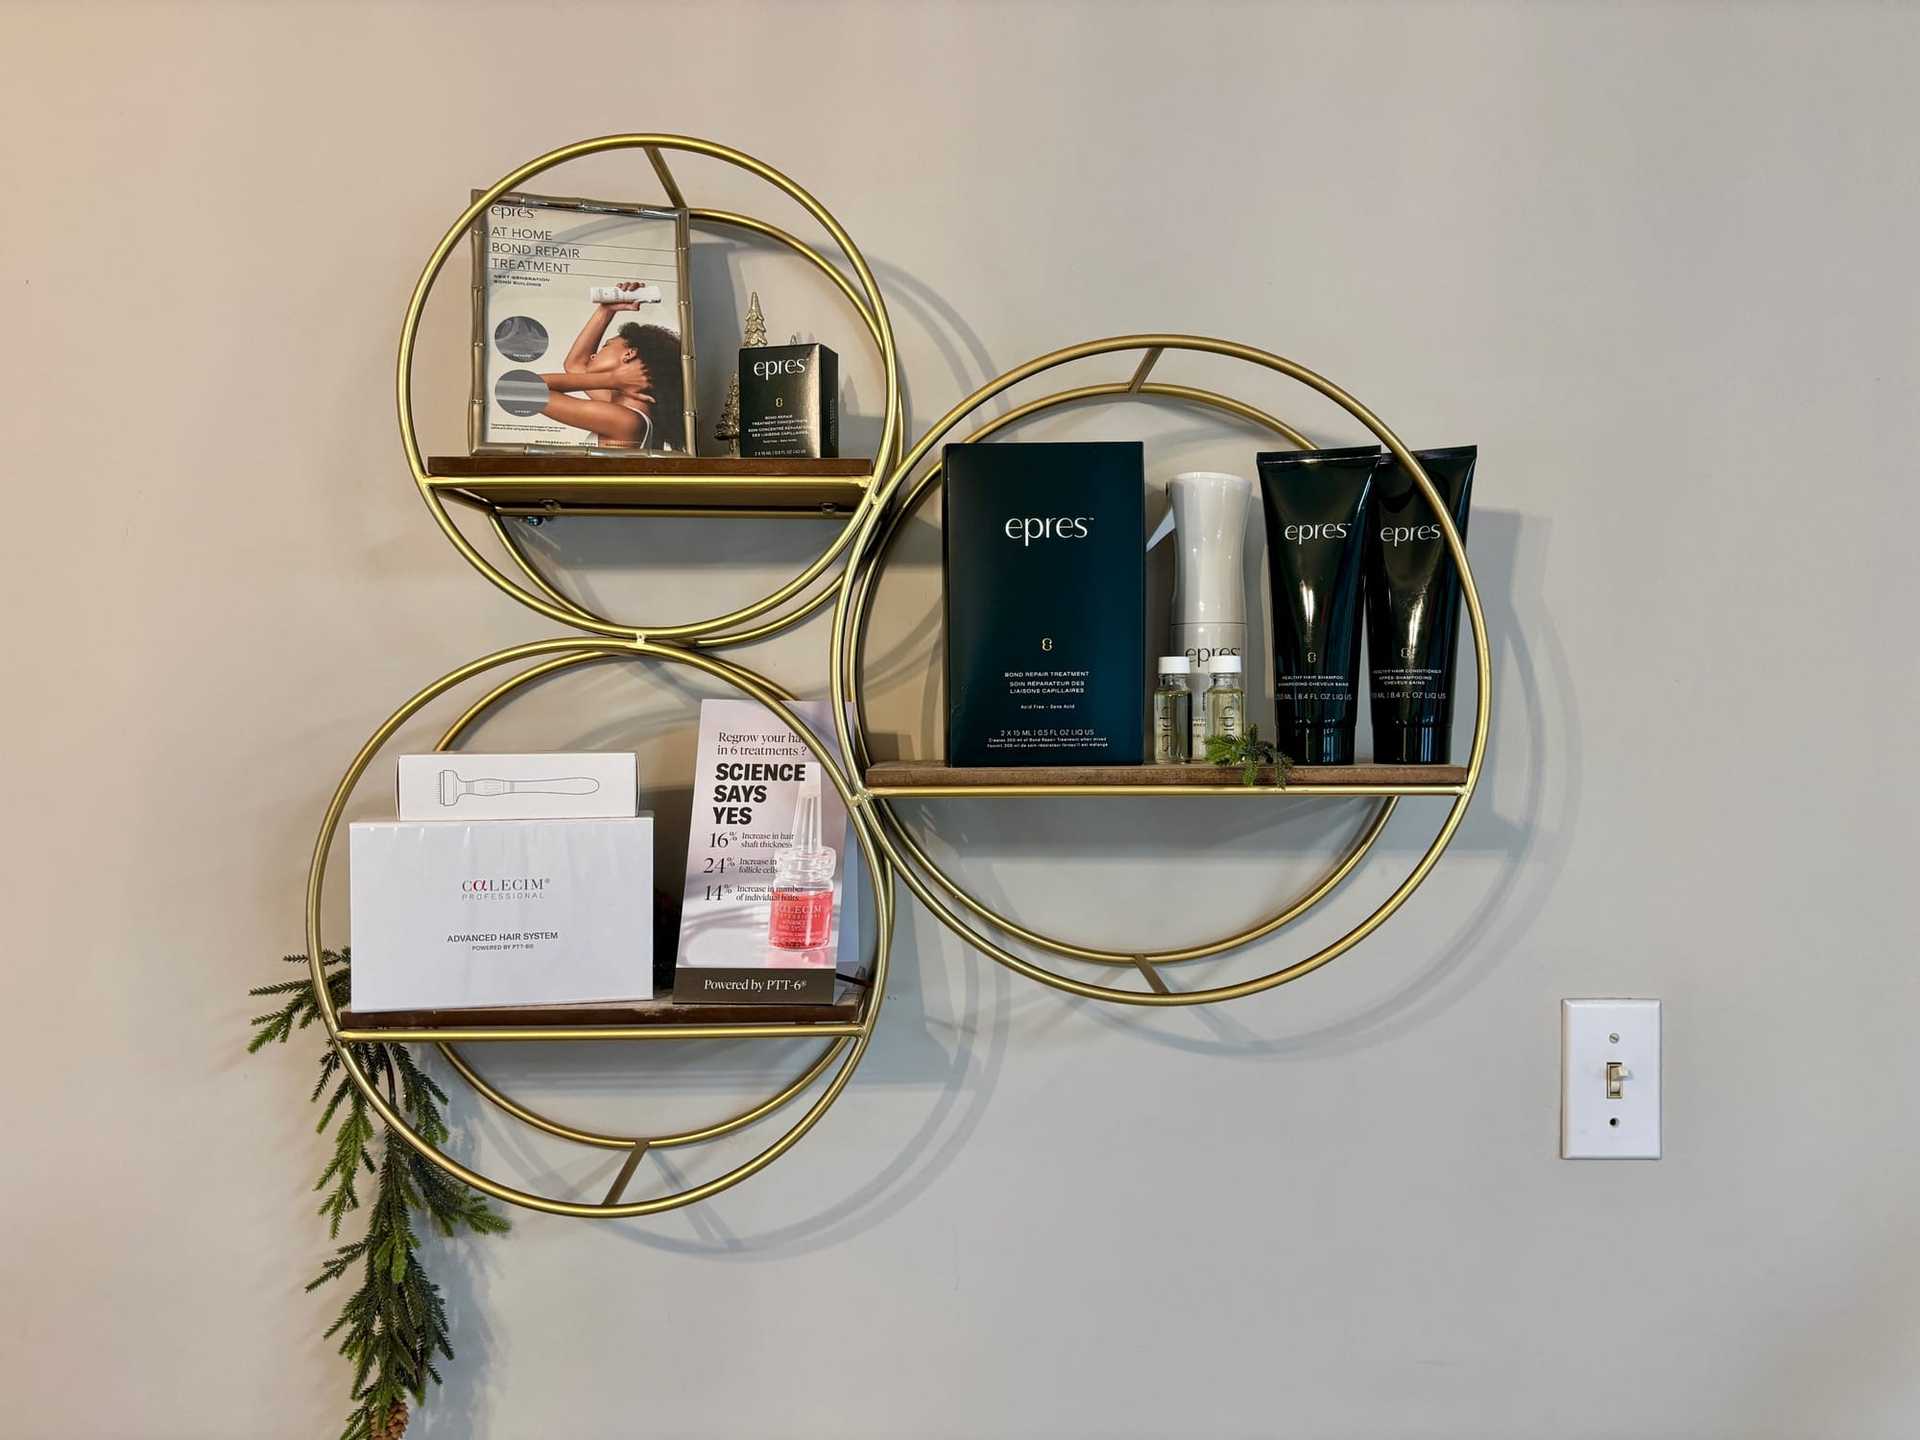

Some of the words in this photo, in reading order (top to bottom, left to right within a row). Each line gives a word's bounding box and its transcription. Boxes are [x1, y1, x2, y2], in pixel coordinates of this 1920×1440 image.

[491, 205, 536, 219] epres
[491, 226, 507, 237] AT
[511, 228, 553, 241] HOME
[492, 242, 531, 254] BOND
[535, 246, 580, 258] REPAIR
[491, 258, 571, 273] TREATMENT
[753, 358, 806, 381] epres
[1005, 517, 1089, 547] epres
[1284, 523, 1348, 545] epres
[1379, 523, 1441, 547] epres
[718, 732, 759, 744] Regrow
[761, 733, 785, 745] your
[788, 732, 801, 743] ha
[717, 745, 728, 755] in
[730, 745, 738, 755] 6
[740, 746, 799, 756] treatments
[715, 763, 806, 781] SCIENCE
[713, 784, 767, 803] SAYS
[713, 806, 753, 825] YES
[742, 832, 771, 840] Increase
[772, 832, 779, 840] in
[780, 832, 795, 840] hair
[741, 840, 759, 848] shaft
[759, 840, 793, 848] thickness
[739, 858, 769, 866] Increase
[769, 858, 777, 866] in
[738, 866, 762, 874] follicle
[762, 866, 778, 874] cells
[737, 885, 766, 893] Increase
[767, 885, 775, 893] in
[462, 892, 545, 901] PROFESSIONAL
[736, 893, 745, 902] of
[745, 893, 780, 901] individual
[447, 933, 497, 942] ADVANCED
[499, 933, 521, 941] HAIR
[523, 931, 559, 941] SYSTEM
[704, 979, 749, 990] Powered
[751, 979, 764, 992] by
